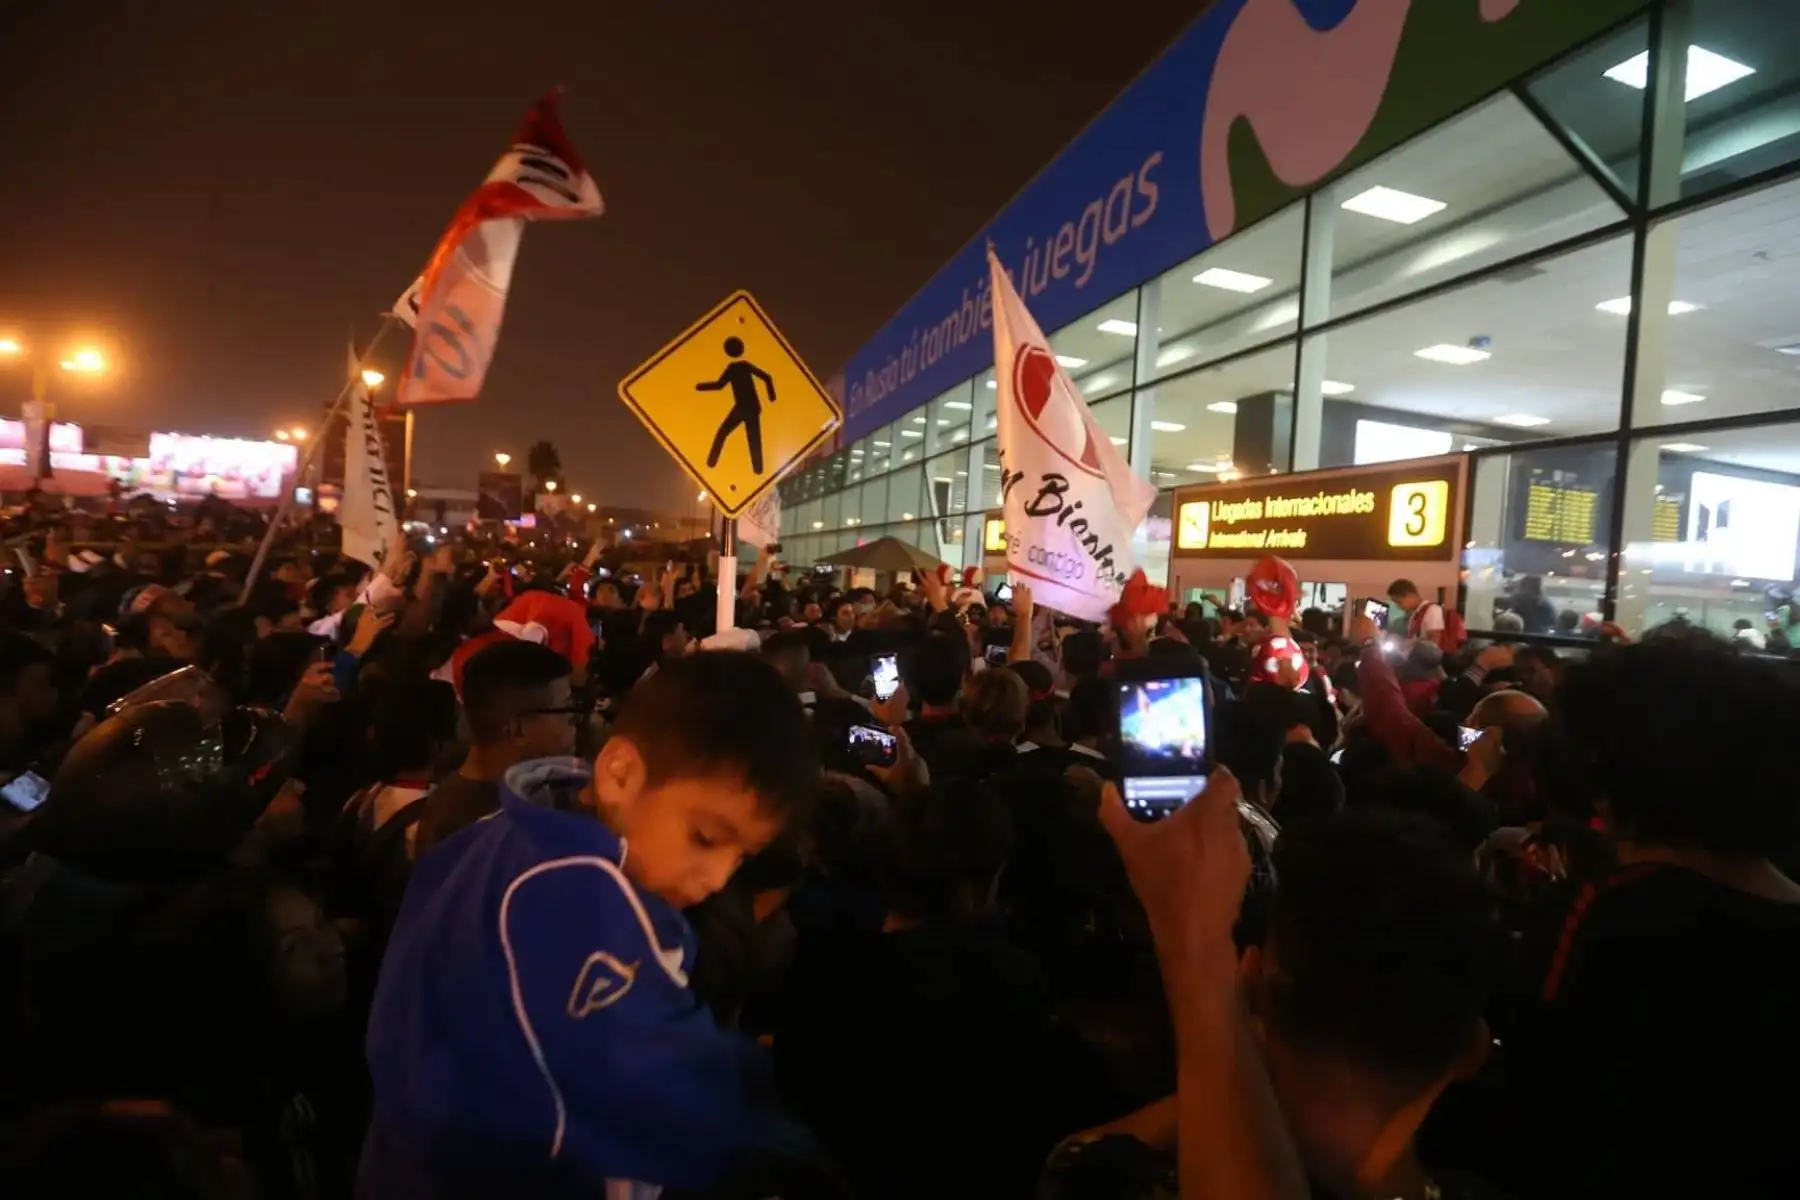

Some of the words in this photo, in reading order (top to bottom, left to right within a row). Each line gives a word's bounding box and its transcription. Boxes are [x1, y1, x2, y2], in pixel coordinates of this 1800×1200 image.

[1019, 152, 1164, 300] juegas
[1211, 498, 1263, 525] Llegadas
[1265, 489, 1375, 518] Internacionales
[1404, 492, 1426, 537] 3
